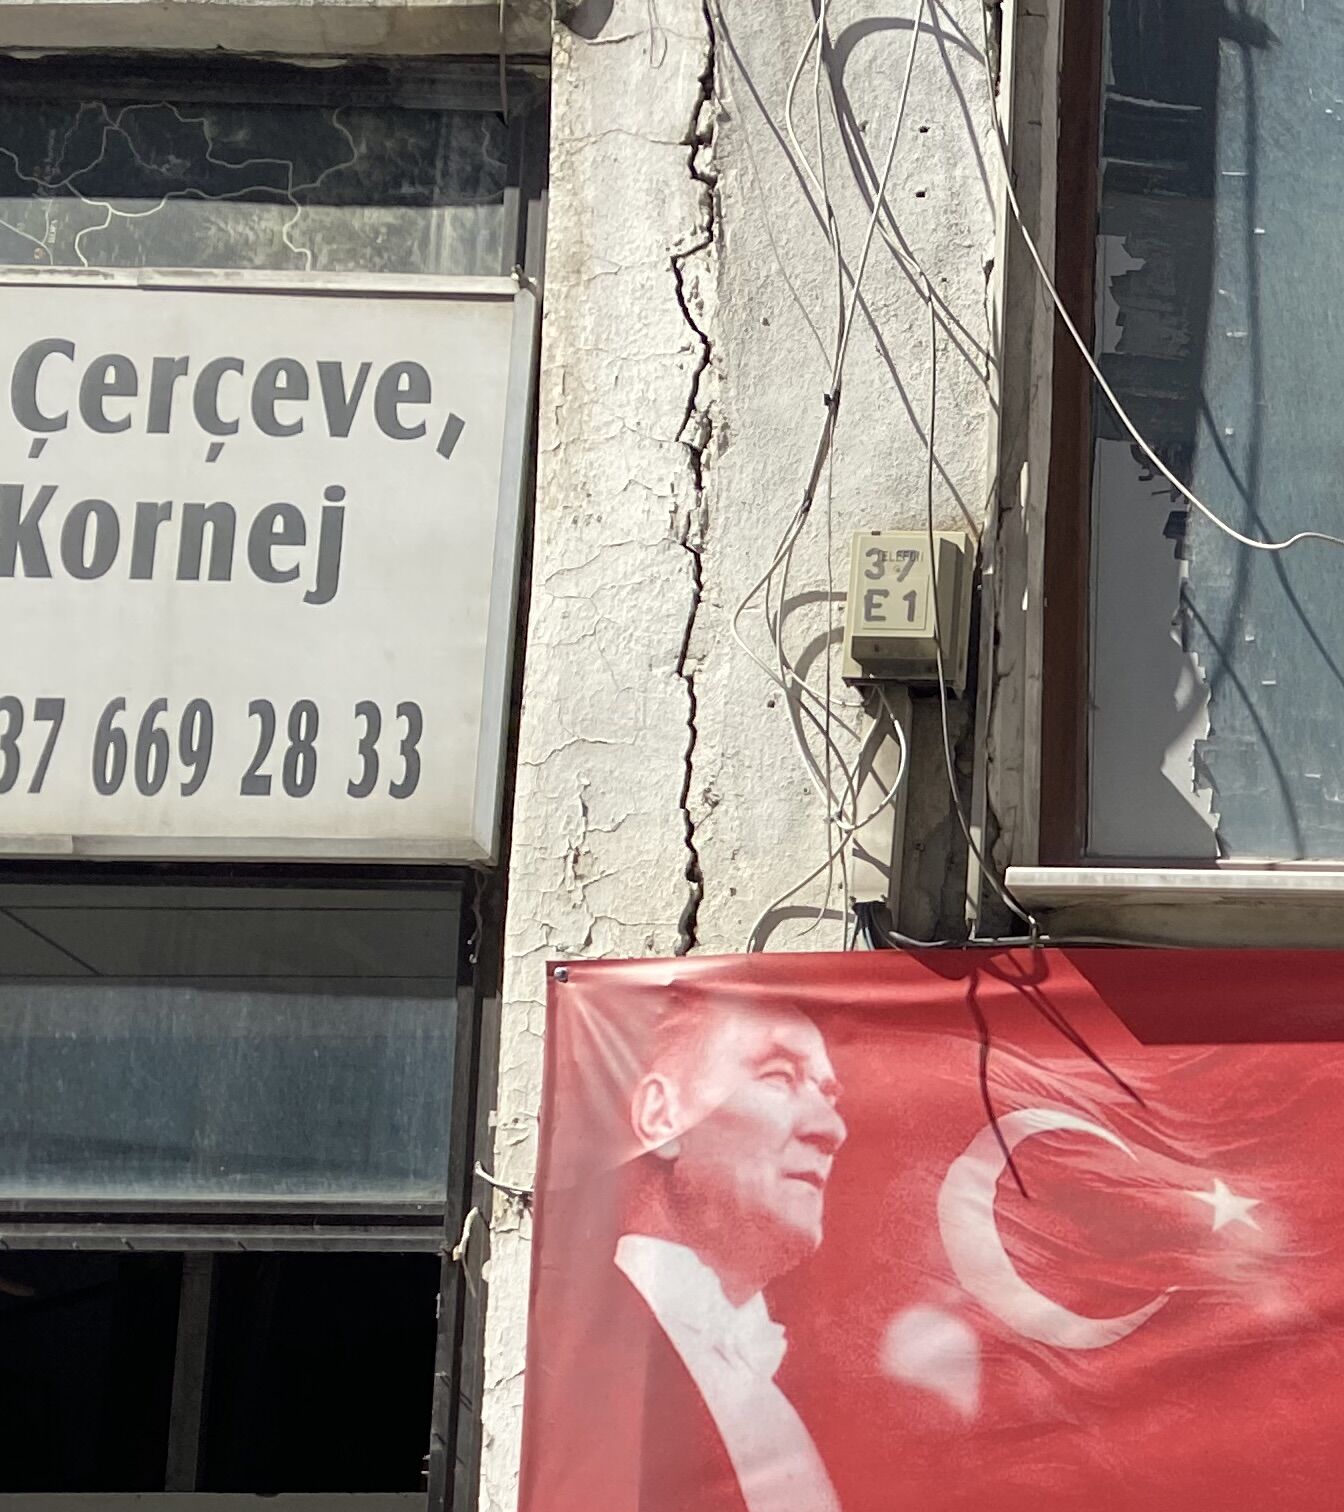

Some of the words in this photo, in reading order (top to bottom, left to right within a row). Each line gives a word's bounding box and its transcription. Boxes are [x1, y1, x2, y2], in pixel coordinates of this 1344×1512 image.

[11, 337, 467, 462] Çerçeve,
[0, 484, 347, 605] Kornej
[864, 547, 920, 583] 37
[92, 696, 214, 798] 669
[240, 697, 321, 799] 28
[346, 699, 424, 800] 33
